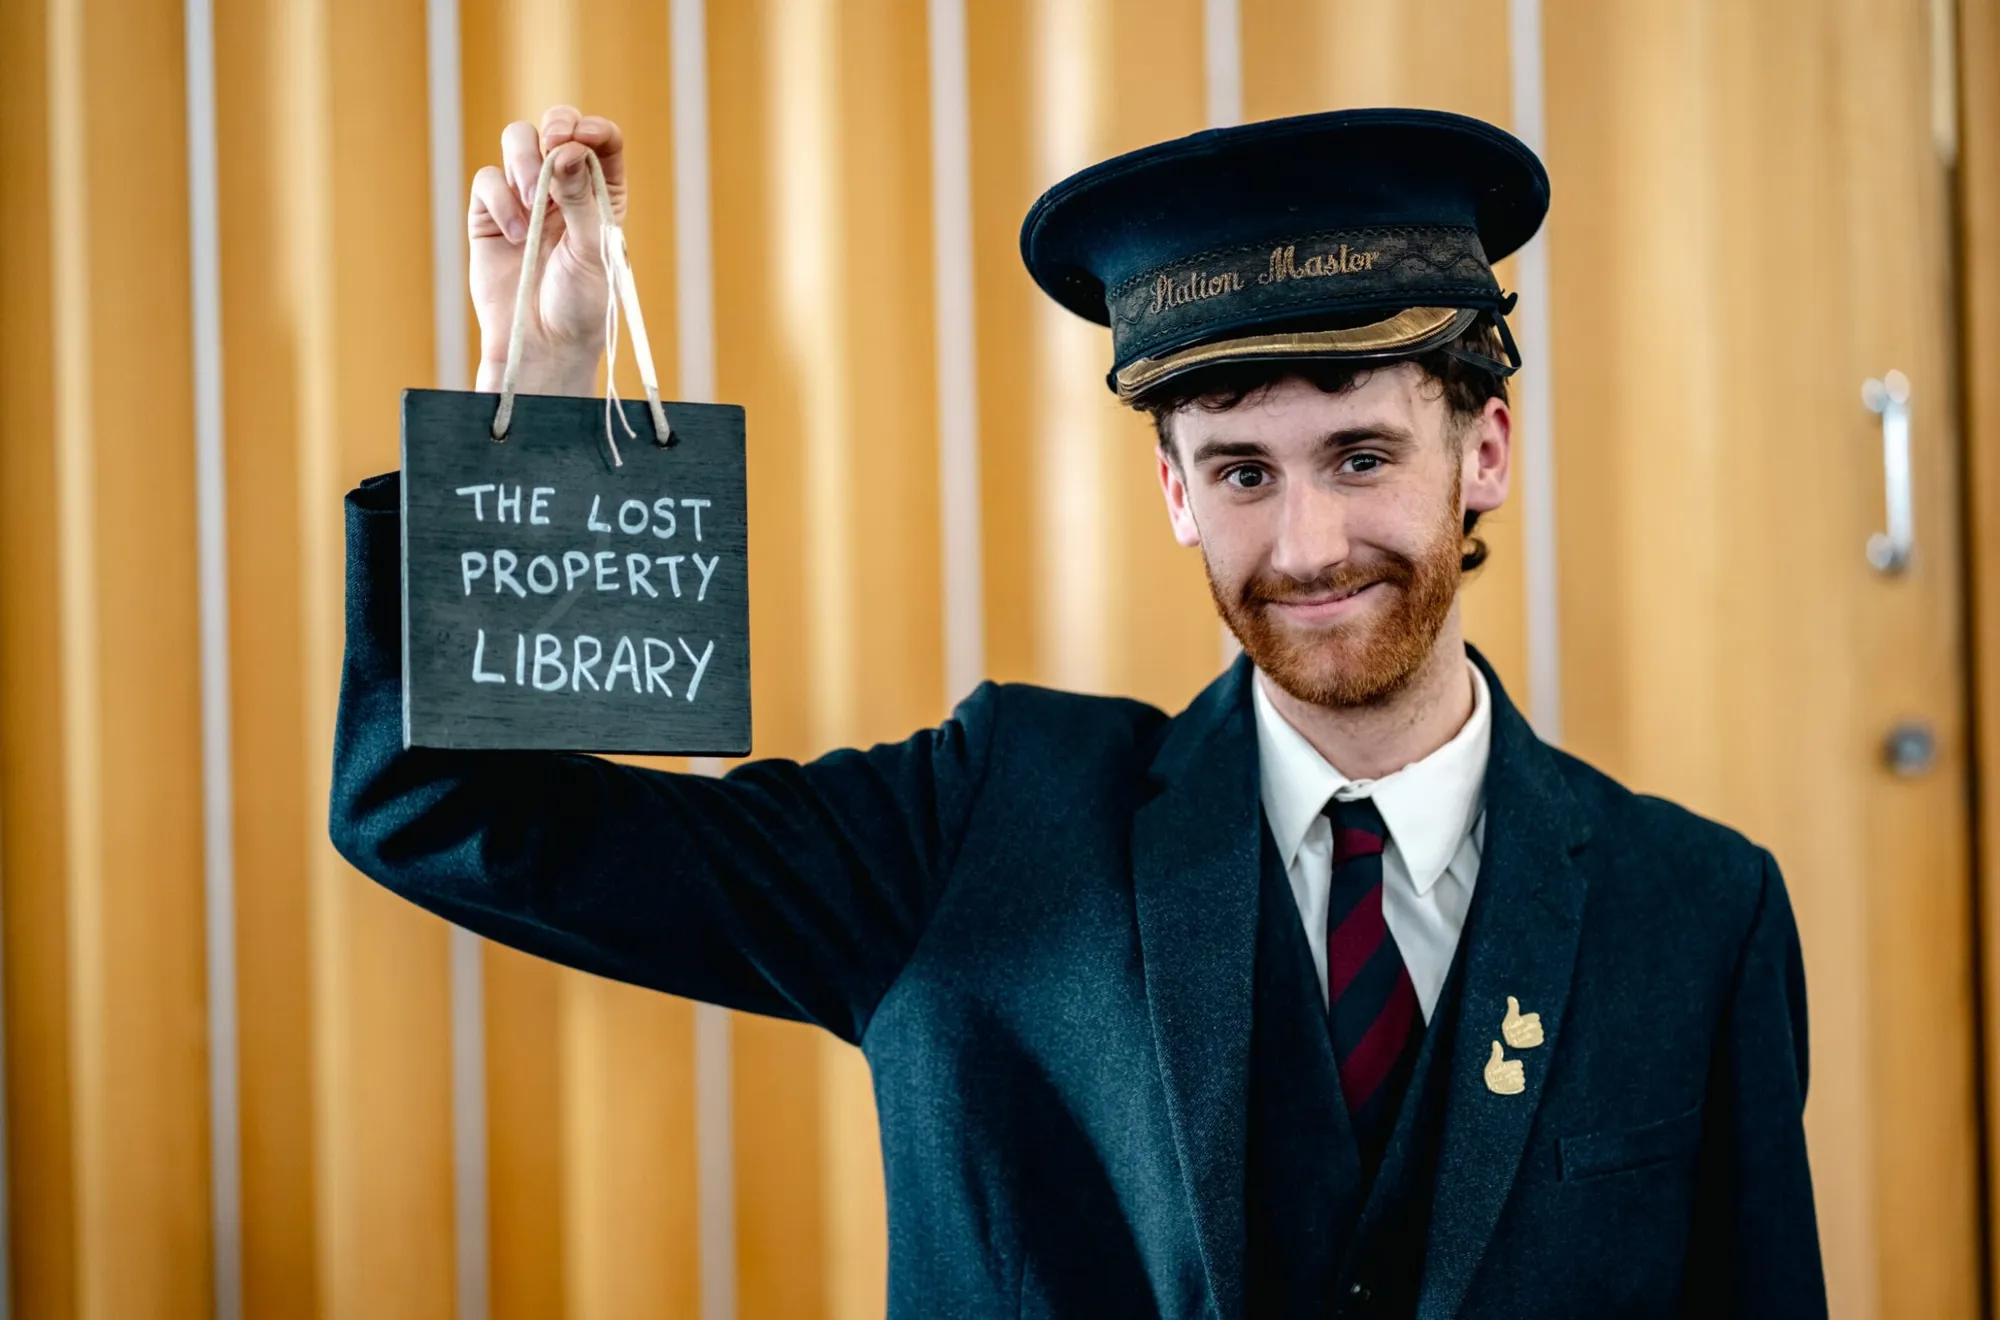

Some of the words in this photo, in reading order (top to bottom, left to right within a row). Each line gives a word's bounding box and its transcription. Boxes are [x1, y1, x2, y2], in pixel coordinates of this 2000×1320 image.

[1151, 271, 1244, 315] Station
[1257, 243, 1380, 285] Master
[455, 483, 556, 525] THE
[587, 494, 712, 541] LOST
[461, 549, 720, 602] PROPERTY
[472, 628, 715, 702] LIBRARY
